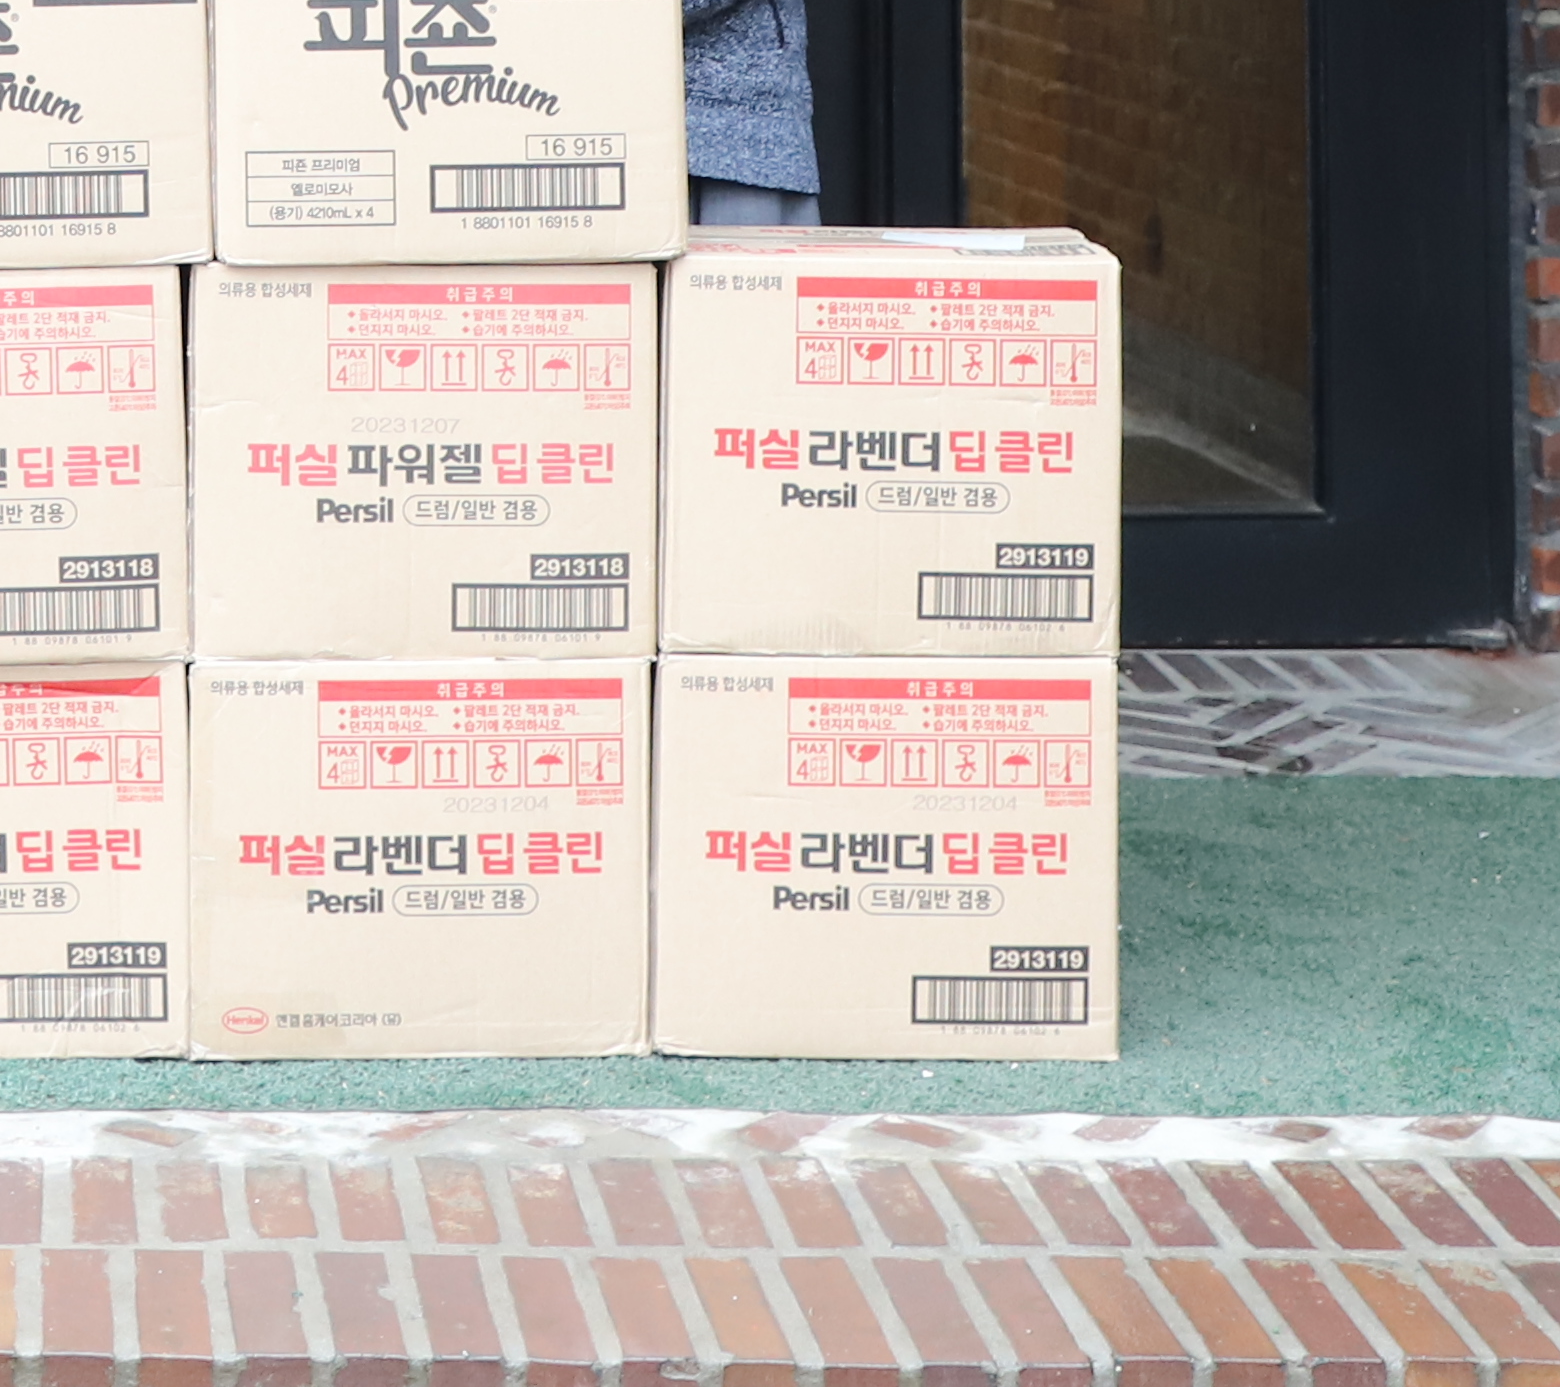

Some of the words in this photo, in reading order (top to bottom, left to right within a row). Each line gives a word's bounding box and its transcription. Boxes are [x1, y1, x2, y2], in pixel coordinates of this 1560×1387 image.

[383, 67, 560, 130] Premium
[64, 146, 88, 164] 16
[96, 145, 136, 163] 915
[541, 139, 566, 156] 16
[574, 138, 613, 155] 915
[218, 282, 256, 297] 의류용
[260, 282, 312, 298] 합성세제
[690, 274, 728, 290] 의류용
[731, 275, 783, 291] 합성세제
[351, 417, 460, 434] 20231207
[714, 427, 800, 469] 퍼실
[809, 430, 941, 472] 라벤더
[949, 432, 985, 473] 딥
[995, 432, 1073, 473] 클린
[18, 447, 54, 487] 딥
[62, 444, 141, 486] 클린
[247, 442, 338, 486] 퍼실
[347, 443, 482, 486] 파워젤
[492, 443, 528, 485] 딥
[536, 442, 614, 484] 클린
[781, 483, 857, 508] Persil
[878, 486, 958, 506] 드럼/일반
[964, 487, 998, 508] 겸용
[30, 503, 65, 524] 겸용
[317, 498, 394, 523] Persil
[415, 499, 496, 520] 드럼/일반
[503, 500, 537, 520] 겸용
[999, 548, 1089, 566] 2913119
[62, 558, 154, 579] 2913118
[534, 559, 624, 577] 2913118
[210, 680, 249, 695] 의류용
[253, 681, 304, 695] 합성세제
[681, 676, 719, 691] 의류용
[723, 677, 774, 692] 합성세제
[442, 796, 549, 813] 20231204
[912, 795, 1017, 811] 20231204
[16, 831, 53, 873] 딥
[62, 829, 142, 871] 클린
[239, 835, 325, 875] 퍼실
[334, 836, 468, 875] 라벤더
[478, 833, 514, 874] 딥
[523, 832, 602, 874] 클린
[706, 831, 791, 872] 퍼실
[801, 832, 934, 874] 라벤더
[943, 833, 978, 874] 딥
[988, 832, 1067, 875] 클린
[32, 888, 67, 908] 겸용
[307, 888, 383, 913] Persil
[405, 890, 485, 909] 드럼/일반
[492, 891, 526, 909] 겸용
[774, 886, 849, 910] Persil
[871, 889, 951, 908] 드럼/일반
[957, 890, 992, 910] 겸용
[71, 947, 161, 966] 2913119
[993, 951, 1084, 969] 2913119
